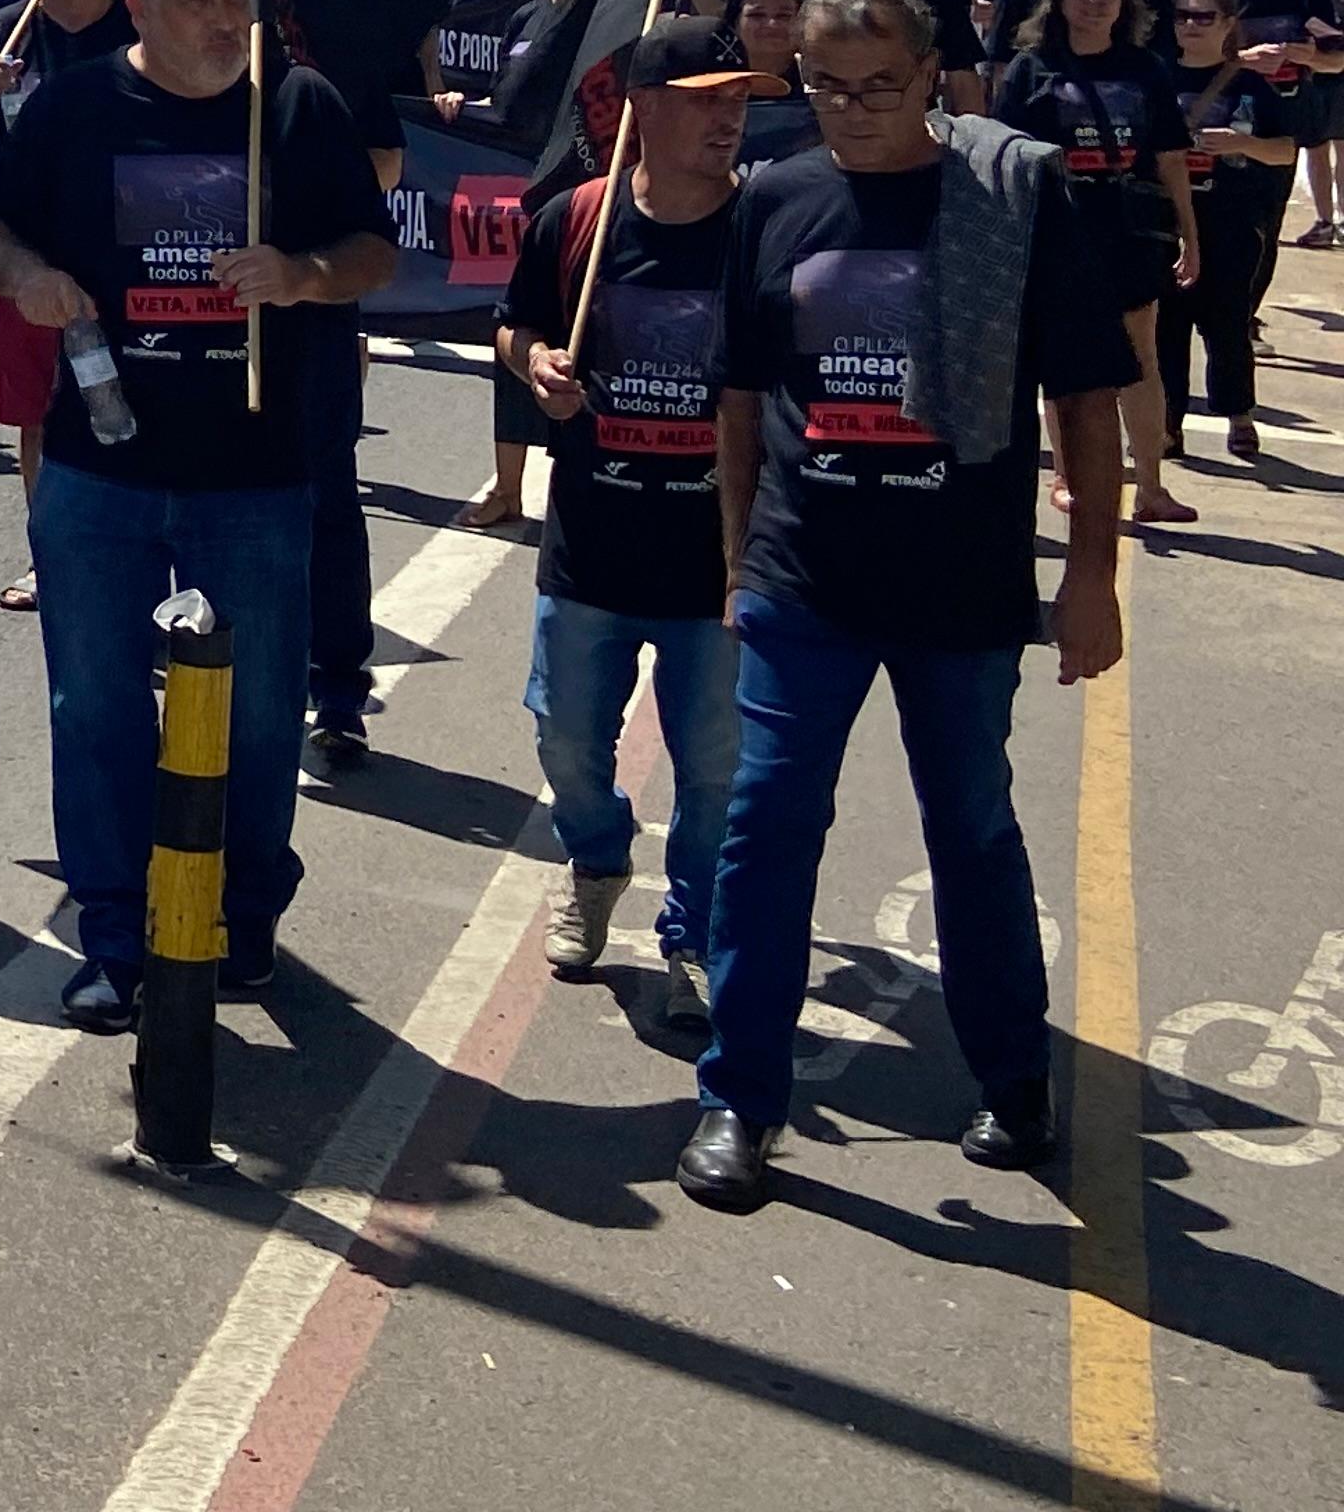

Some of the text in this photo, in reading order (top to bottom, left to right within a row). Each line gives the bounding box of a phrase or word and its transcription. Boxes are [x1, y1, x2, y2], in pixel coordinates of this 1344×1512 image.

[387, 190, 434, 250] CIA.
[155, 229, 235, 246] O PLL244
[148, 264, 198, 281] todos
[130, 296, 192, 314] VETA,
[833, 336, 908, 354] O PLL24
[623, 359, 704, 379] O PLL244
[819, 355, 915, 383] ameaç
[610, 375, 709, 405] ameaça
[824, 376, 909, 398] todos nó
[613, 396, 702, 417] todos nós!
